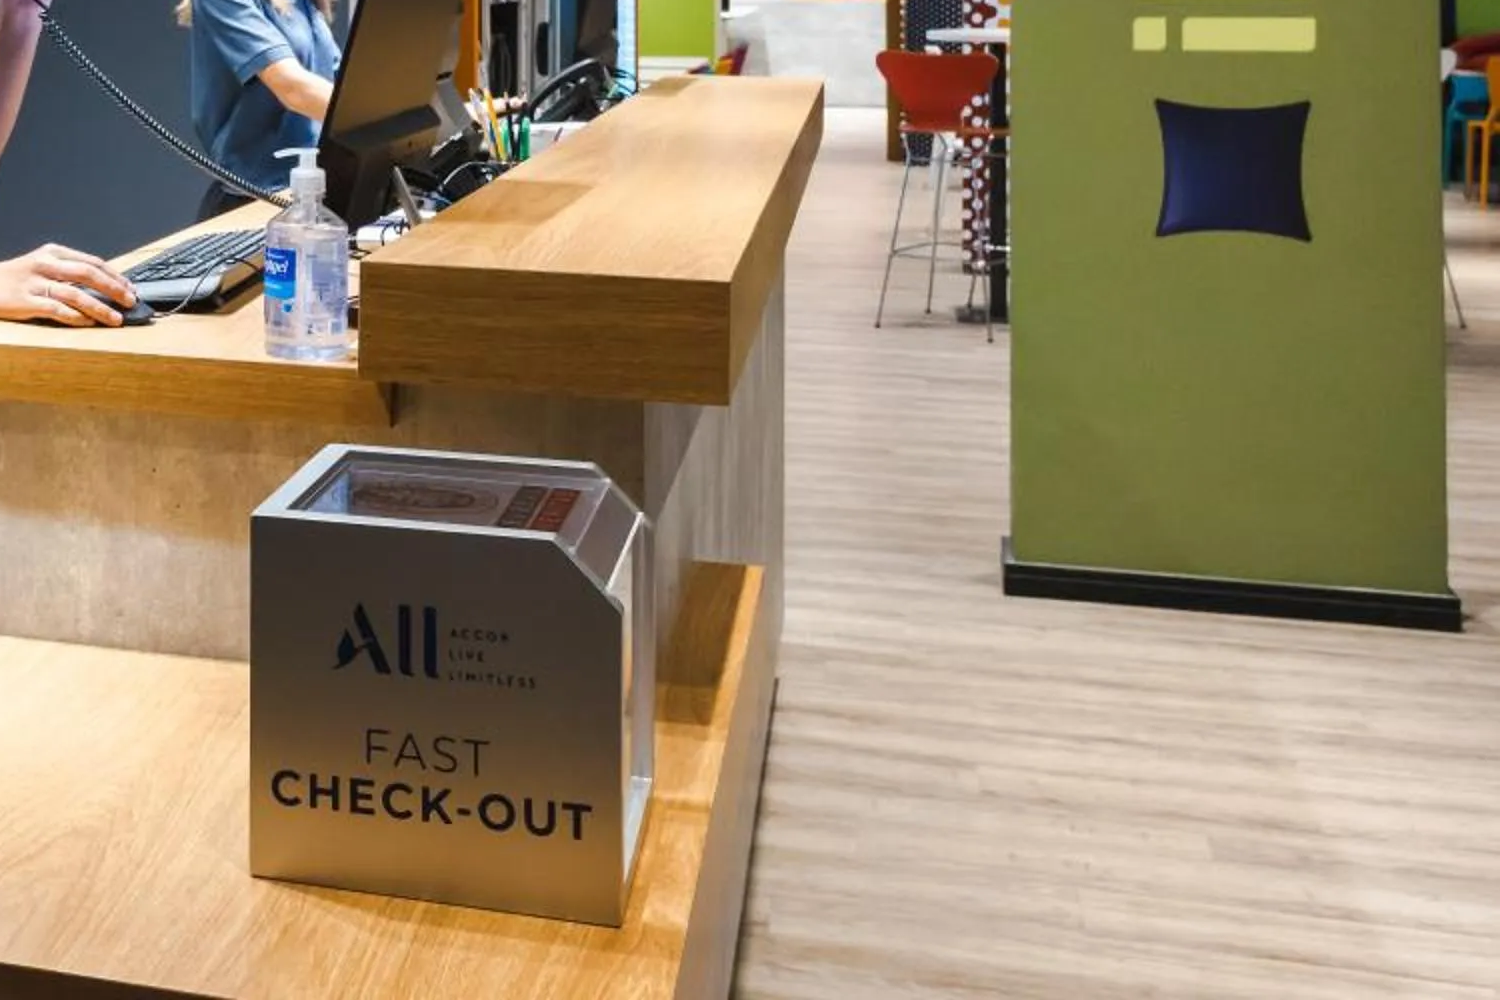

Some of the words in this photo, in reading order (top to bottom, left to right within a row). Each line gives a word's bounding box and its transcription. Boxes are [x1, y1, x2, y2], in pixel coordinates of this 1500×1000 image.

[447, 647, 485, 664] LIVE
[364, 727, 491, 778] FAST
[270, 768, 593, 841] CHECK-OUT
